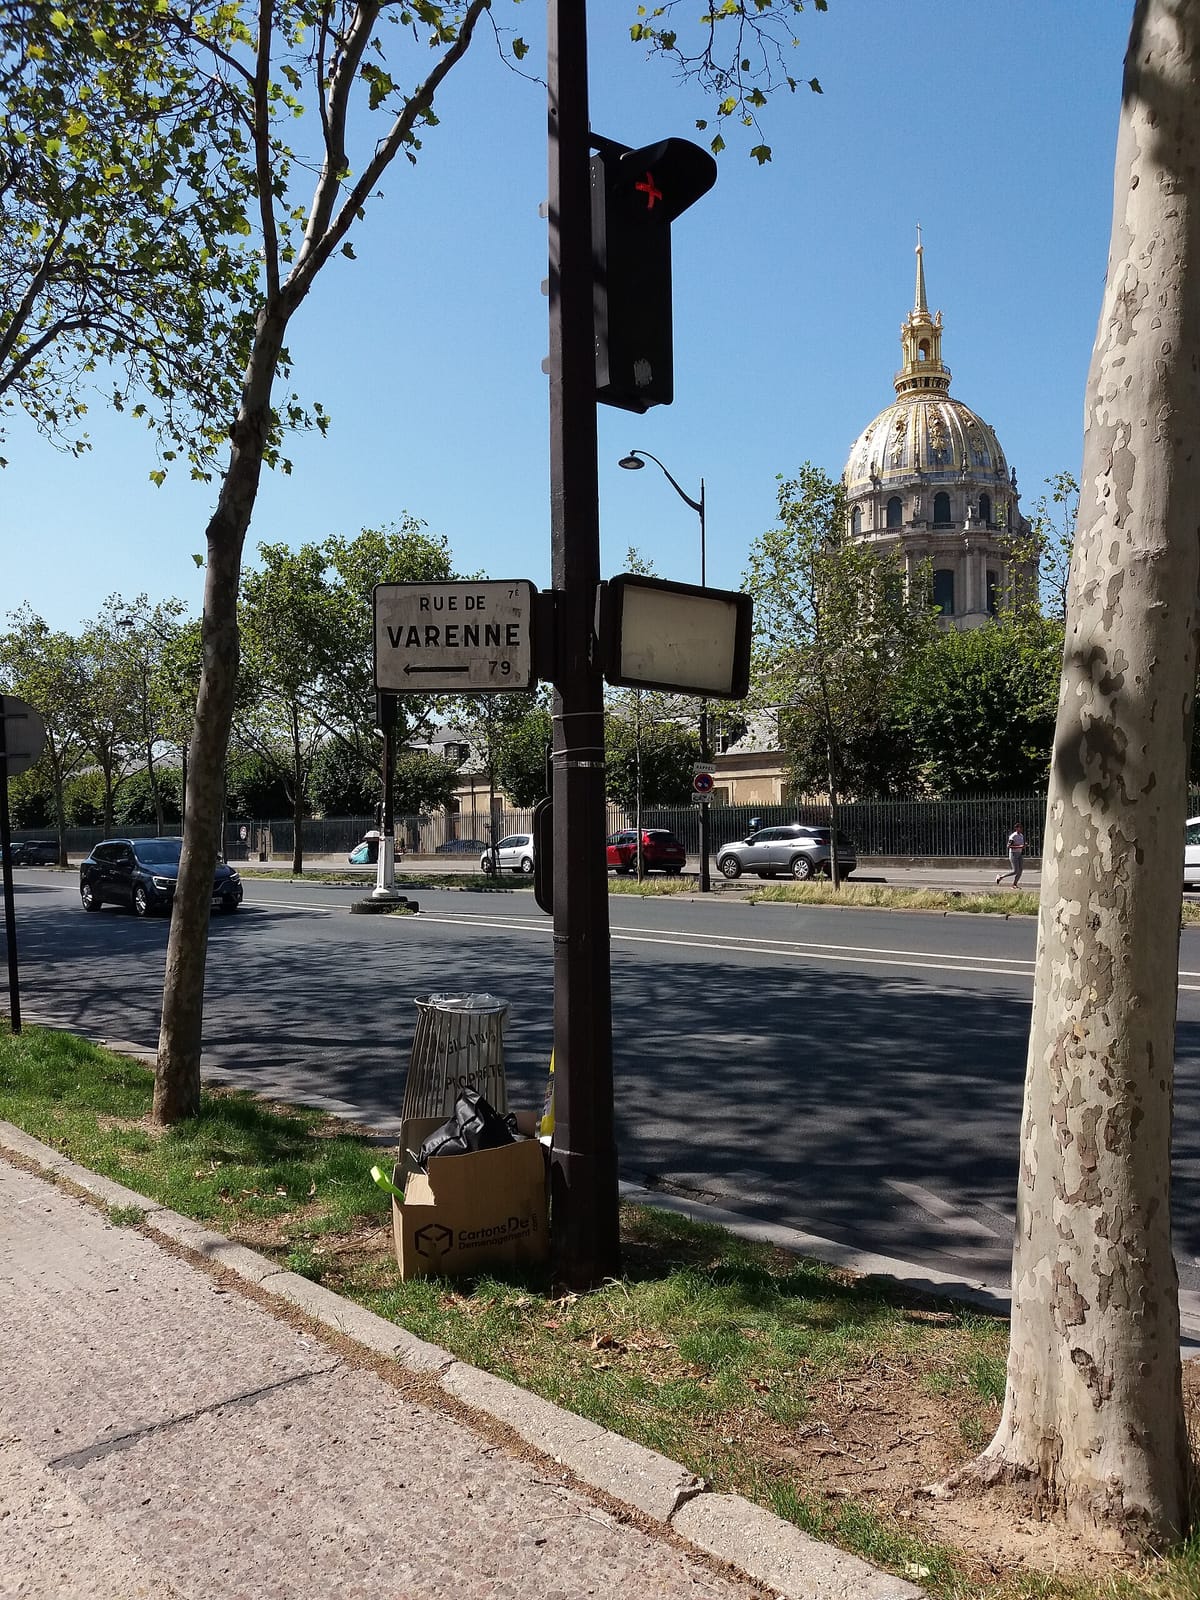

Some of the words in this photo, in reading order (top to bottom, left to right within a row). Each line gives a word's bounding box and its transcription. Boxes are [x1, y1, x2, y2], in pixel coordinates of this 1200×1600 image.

[420, 596, 458, 611] RUE
[465, 595, 486, 611] DE
[387, 624, 520, 648] VARENNE
[488, 660, 511, 675] 79
